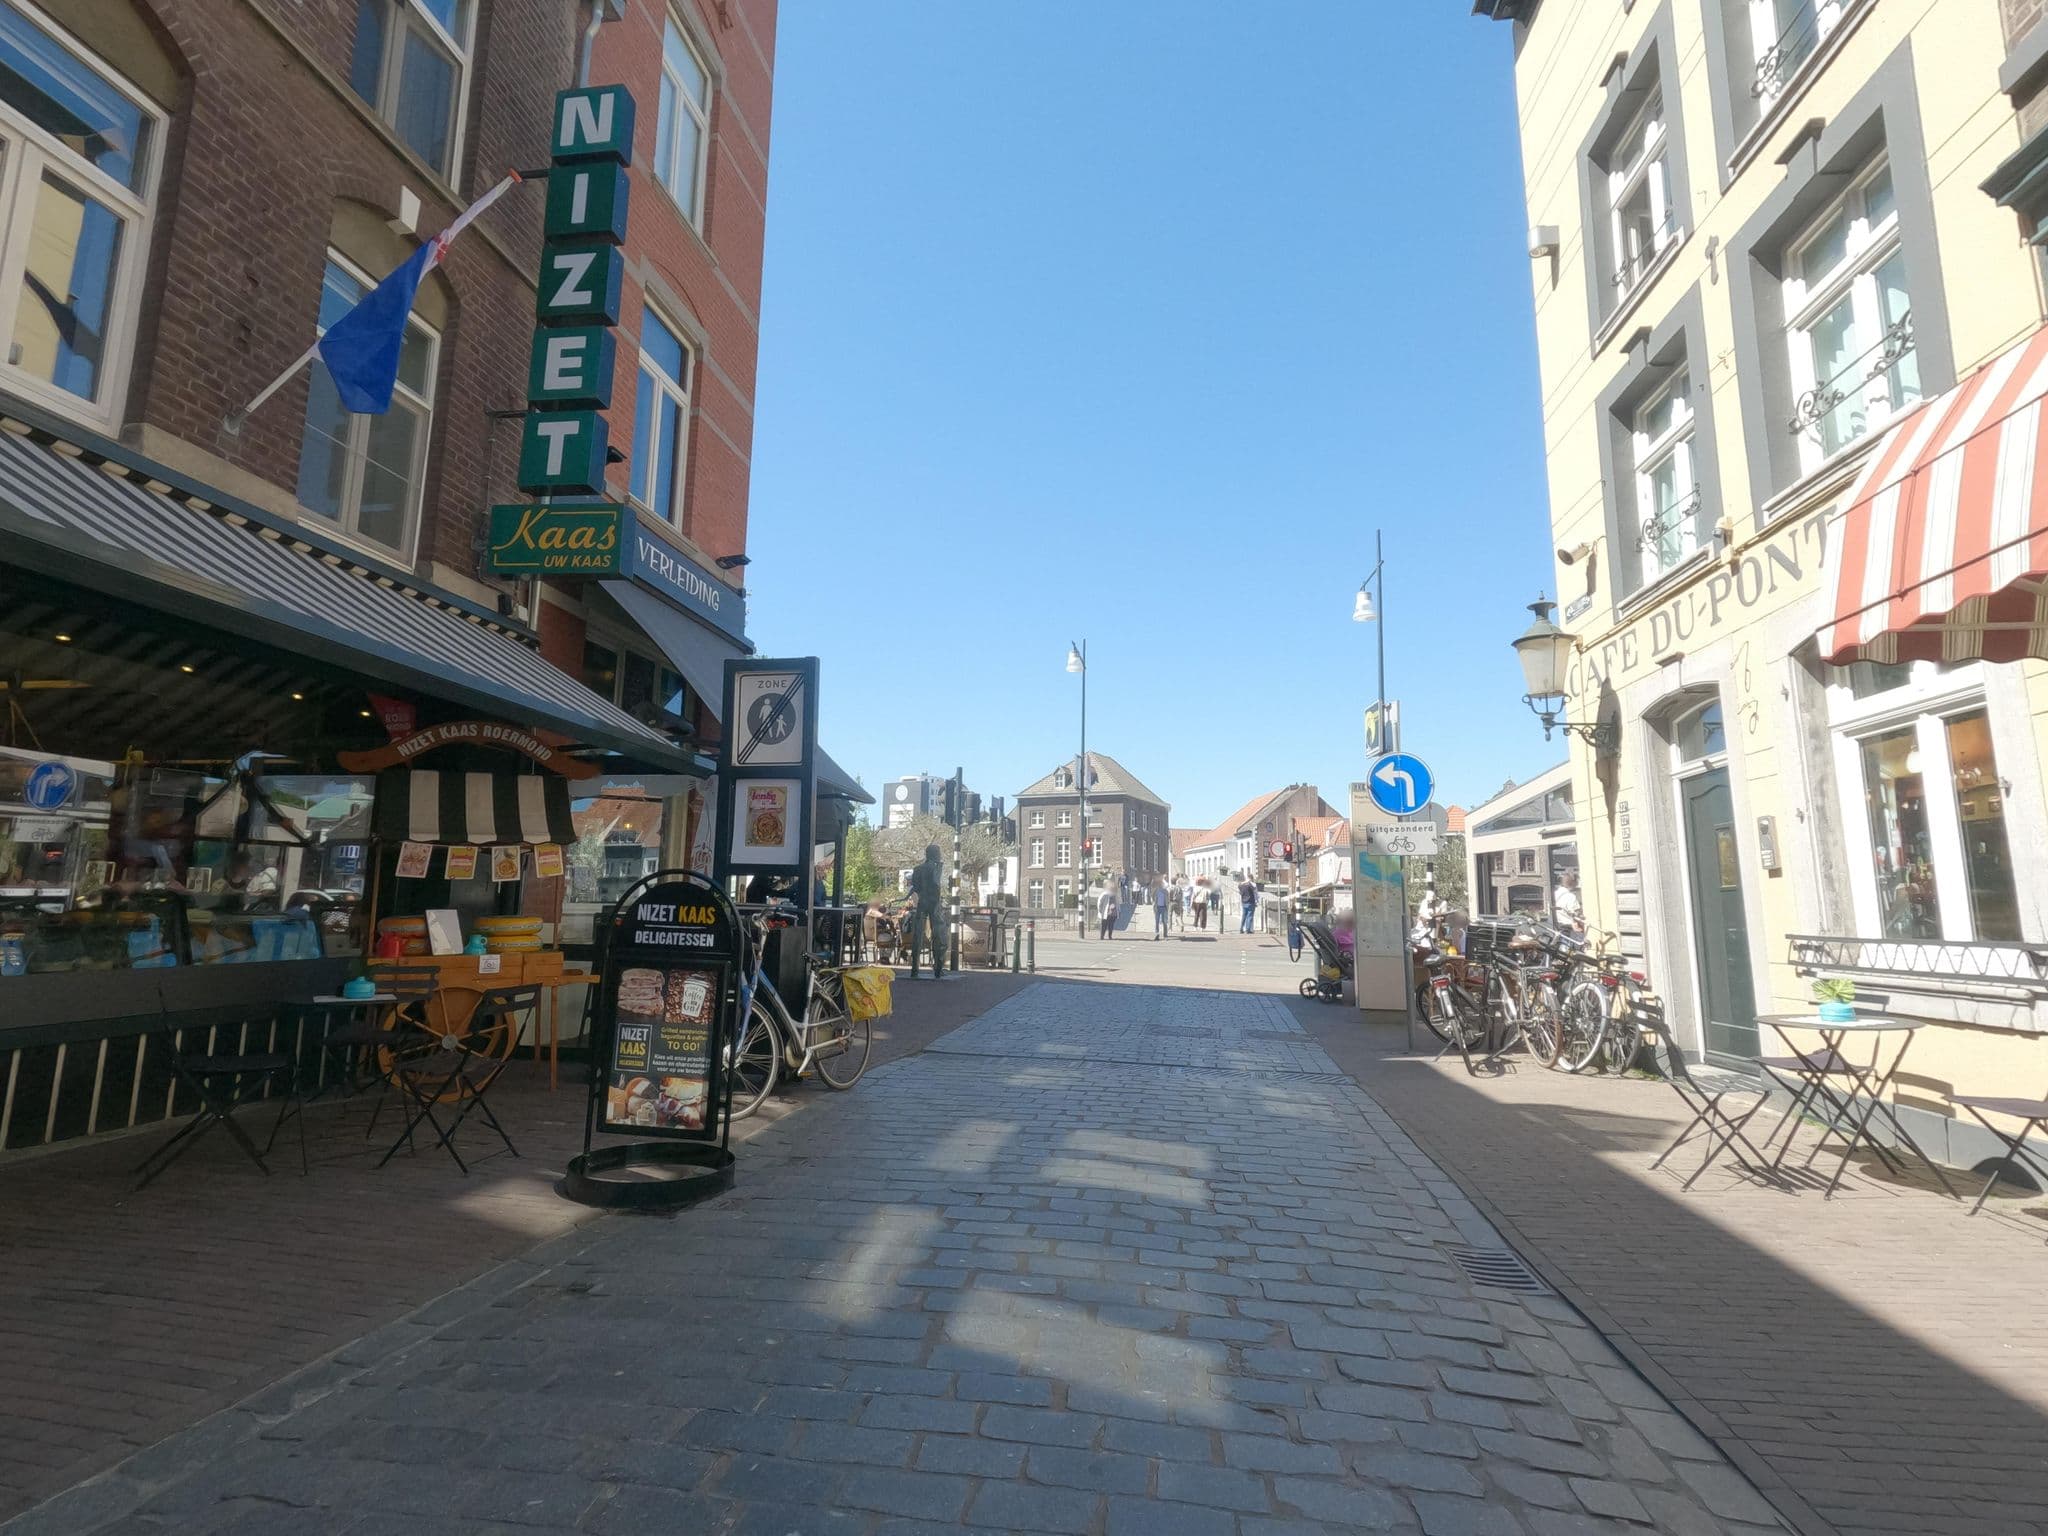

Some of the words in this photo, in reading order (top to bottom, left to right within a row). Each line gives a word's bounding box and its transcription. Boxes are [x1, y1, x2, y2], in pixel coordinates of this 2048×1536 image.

[537, 93, 614, 475] NIZET
[492, 509, 616, 550] Kaas
[544, 554, 567, 568] UW
[570, 554, 612, 568] KAAS
[637, 536, 720, 612] VERLEIDING
[757, 679, 787, 689] ZONE
[396, 731, 437, 757] NIZET
[439, 724, 478, 739] KAAS
[482, 725, 553, 761] ROERMOND
[1369, 825, 1434, 834] uitgezonderd
[637, 903, 676, 922] NIZET
[678, 905, 716, 925] KAAS
[635, 930, 714, 947] DELICATESSEN
[620, 1027, 649, 1041] NIZET
[619, 1041, 646, 1055] KAAS
[667, 1041, 680, 1050] TO
[682, 1042, 700, 1051] GO!
